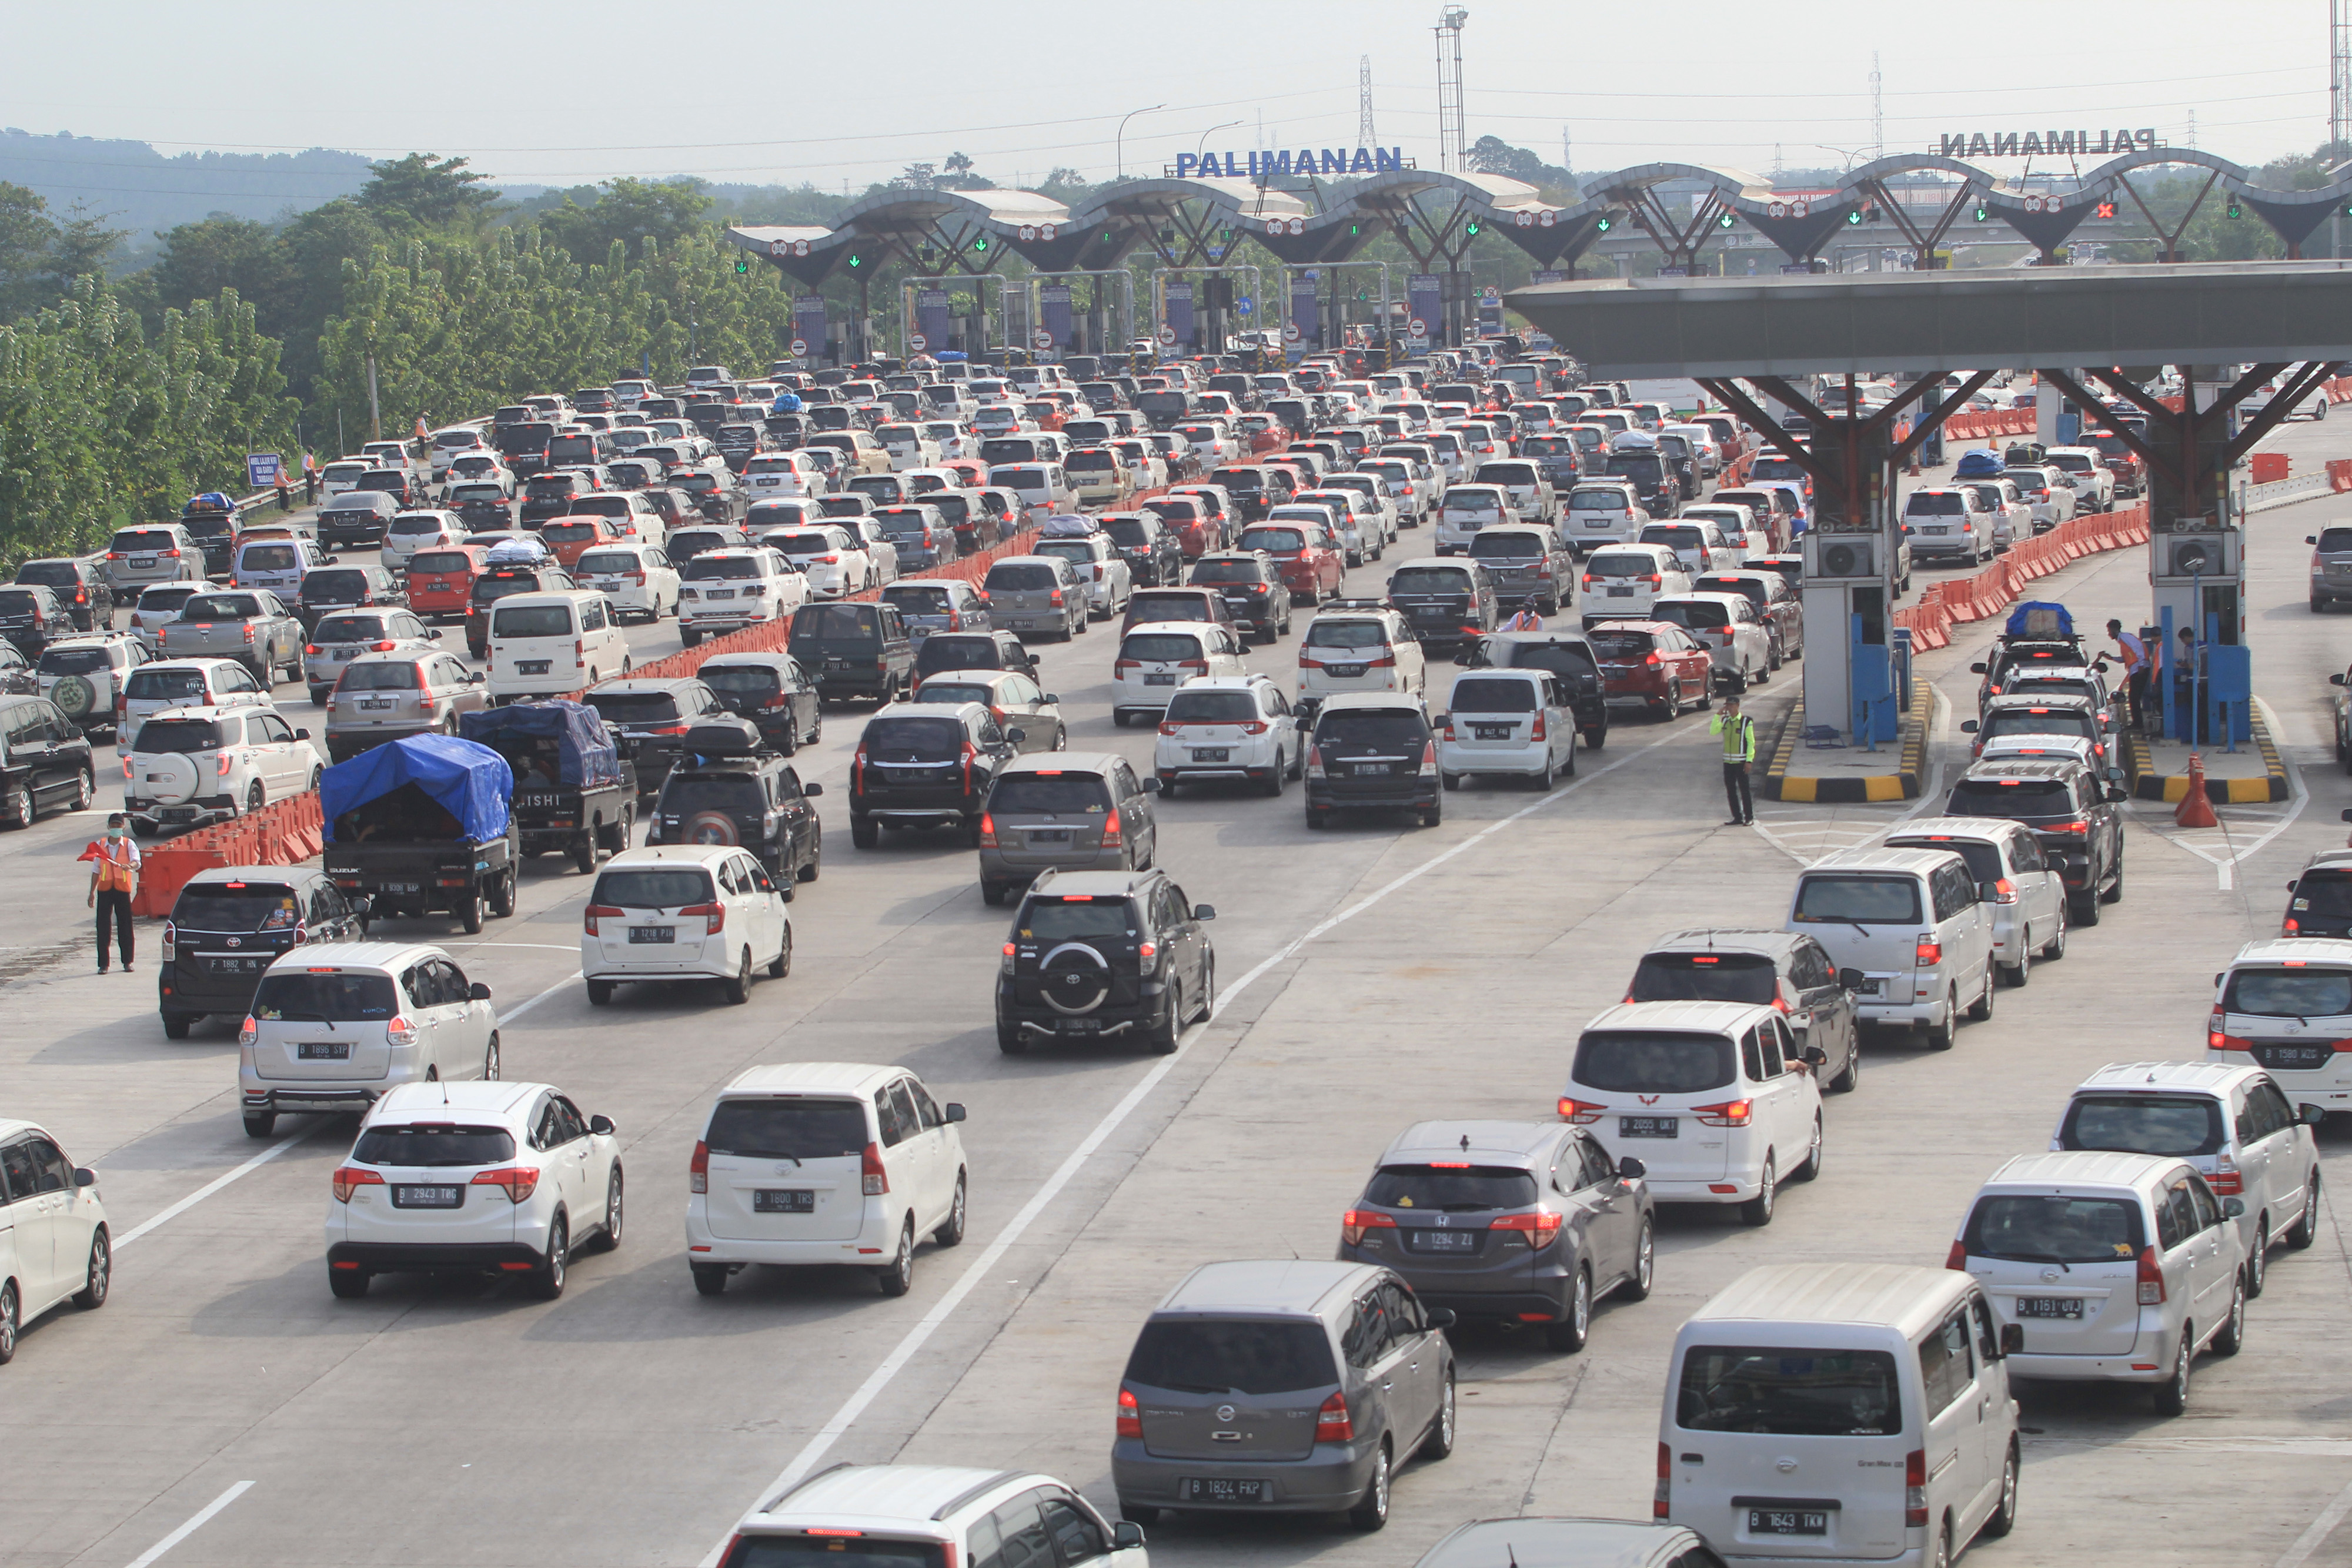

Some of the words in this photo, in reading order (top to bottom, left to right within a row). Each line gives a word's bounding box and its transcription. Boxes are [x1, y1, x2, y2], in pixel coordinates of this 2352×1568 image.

[1177, 147, 1401, 178] PALIMANAN
[260, 457, 270, 465] LAJUR
[212, 959, 216, 968] F
[223, 959, 239, 968] 1882
[247, 959, 256, 968] HN
[312, 1045, 329, 1054] 1896
[334, 1045, 348, 1054] SYP
[2266, 1049, 2272, 1058] B
[1622, 1119, 1628, 1129] B
[400, 1188, 405, 1199] B
[414, 1188, 436, 1199] 2943
[756, 1193, 761, 1203] B
[1413, 1233, 1419, 1243] A
[1432, 1233, 1454, 1244] 1294
[2018, 1299, 2025, 1311] B
[2033, 1299, 2056, 1311] 1161
[1192, 1480, 1200, 1493] B
[1210, 1480, 1234, 1493] 1824
[1240, 1482, 1259, 1494] FKP
[1752, 1513, 1759, 1526] B
[1770, 1513, 1795, 1526] 1643
